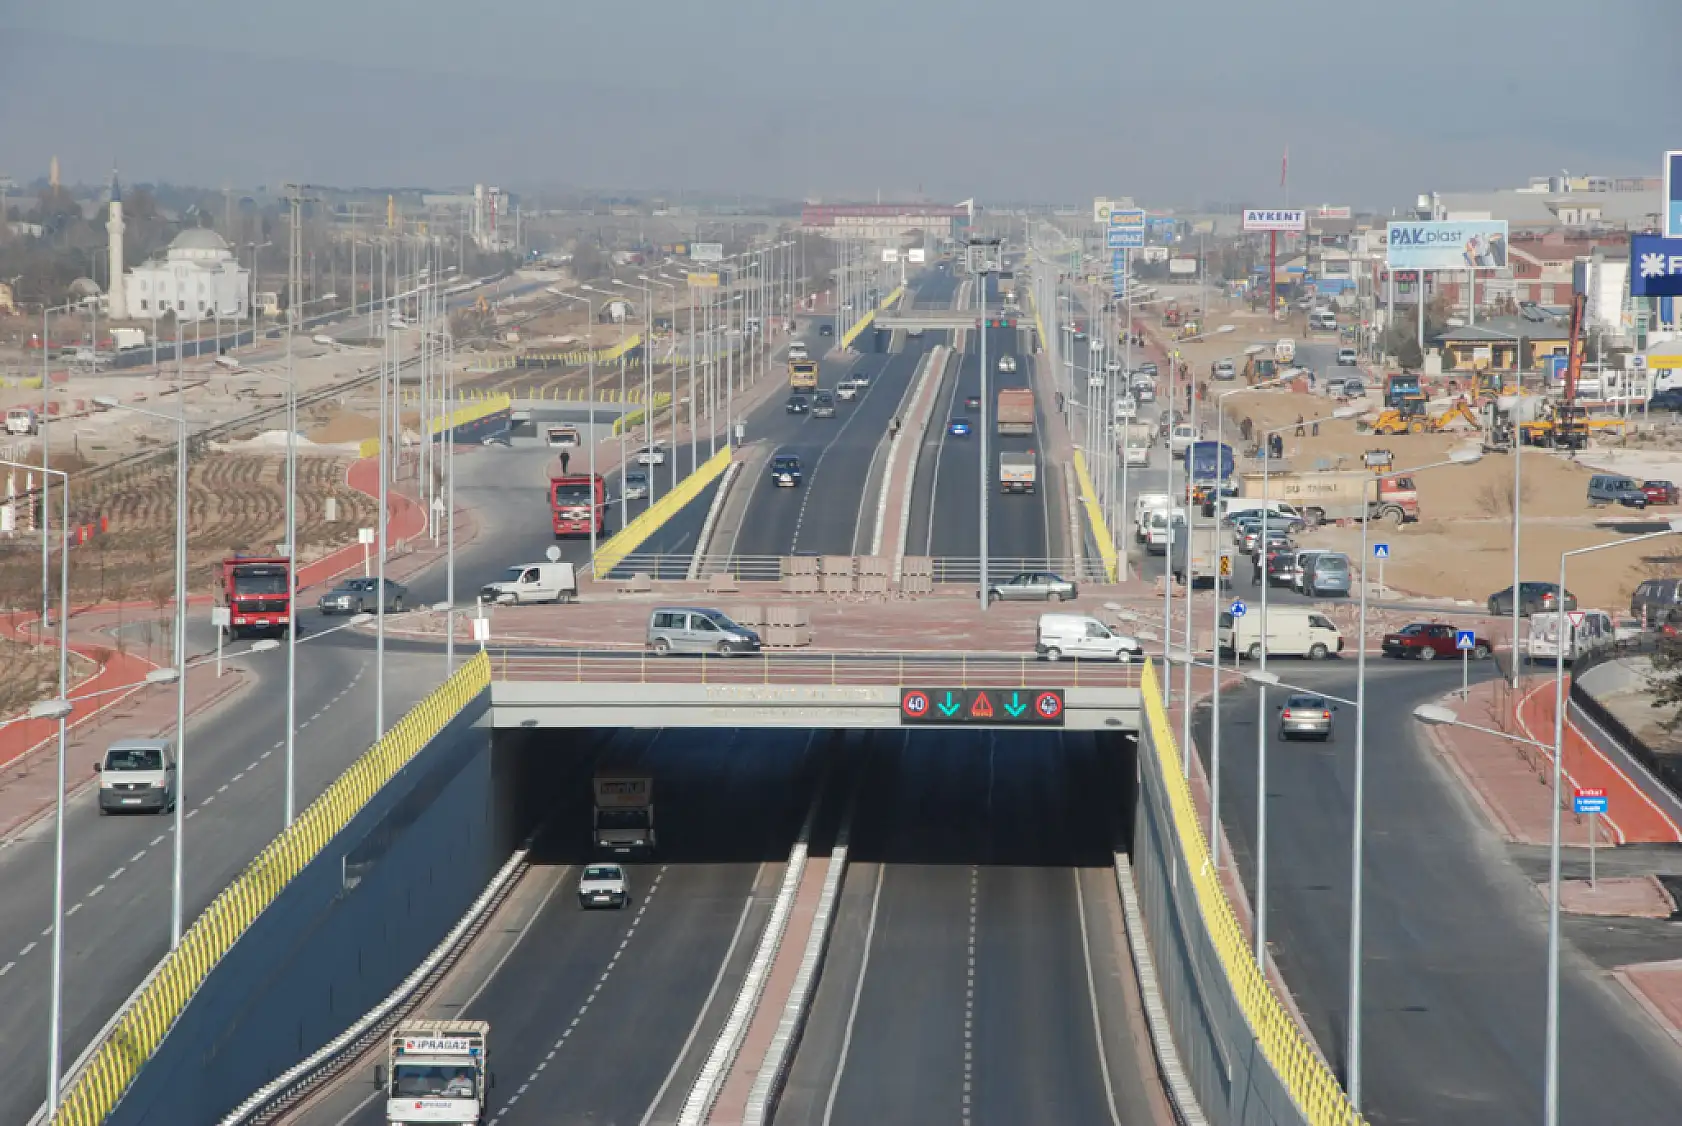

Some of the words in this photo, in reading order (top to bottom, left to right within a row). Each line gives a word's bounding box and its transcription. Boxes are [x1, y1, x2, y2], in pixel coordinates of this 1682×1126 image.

[1248, 211, 1302, 222] AYKENT
[1391, 228, 1425, 245] PAK
[1427, 229, 1462, 242] plast
[908, 697, 925, 711] 40
